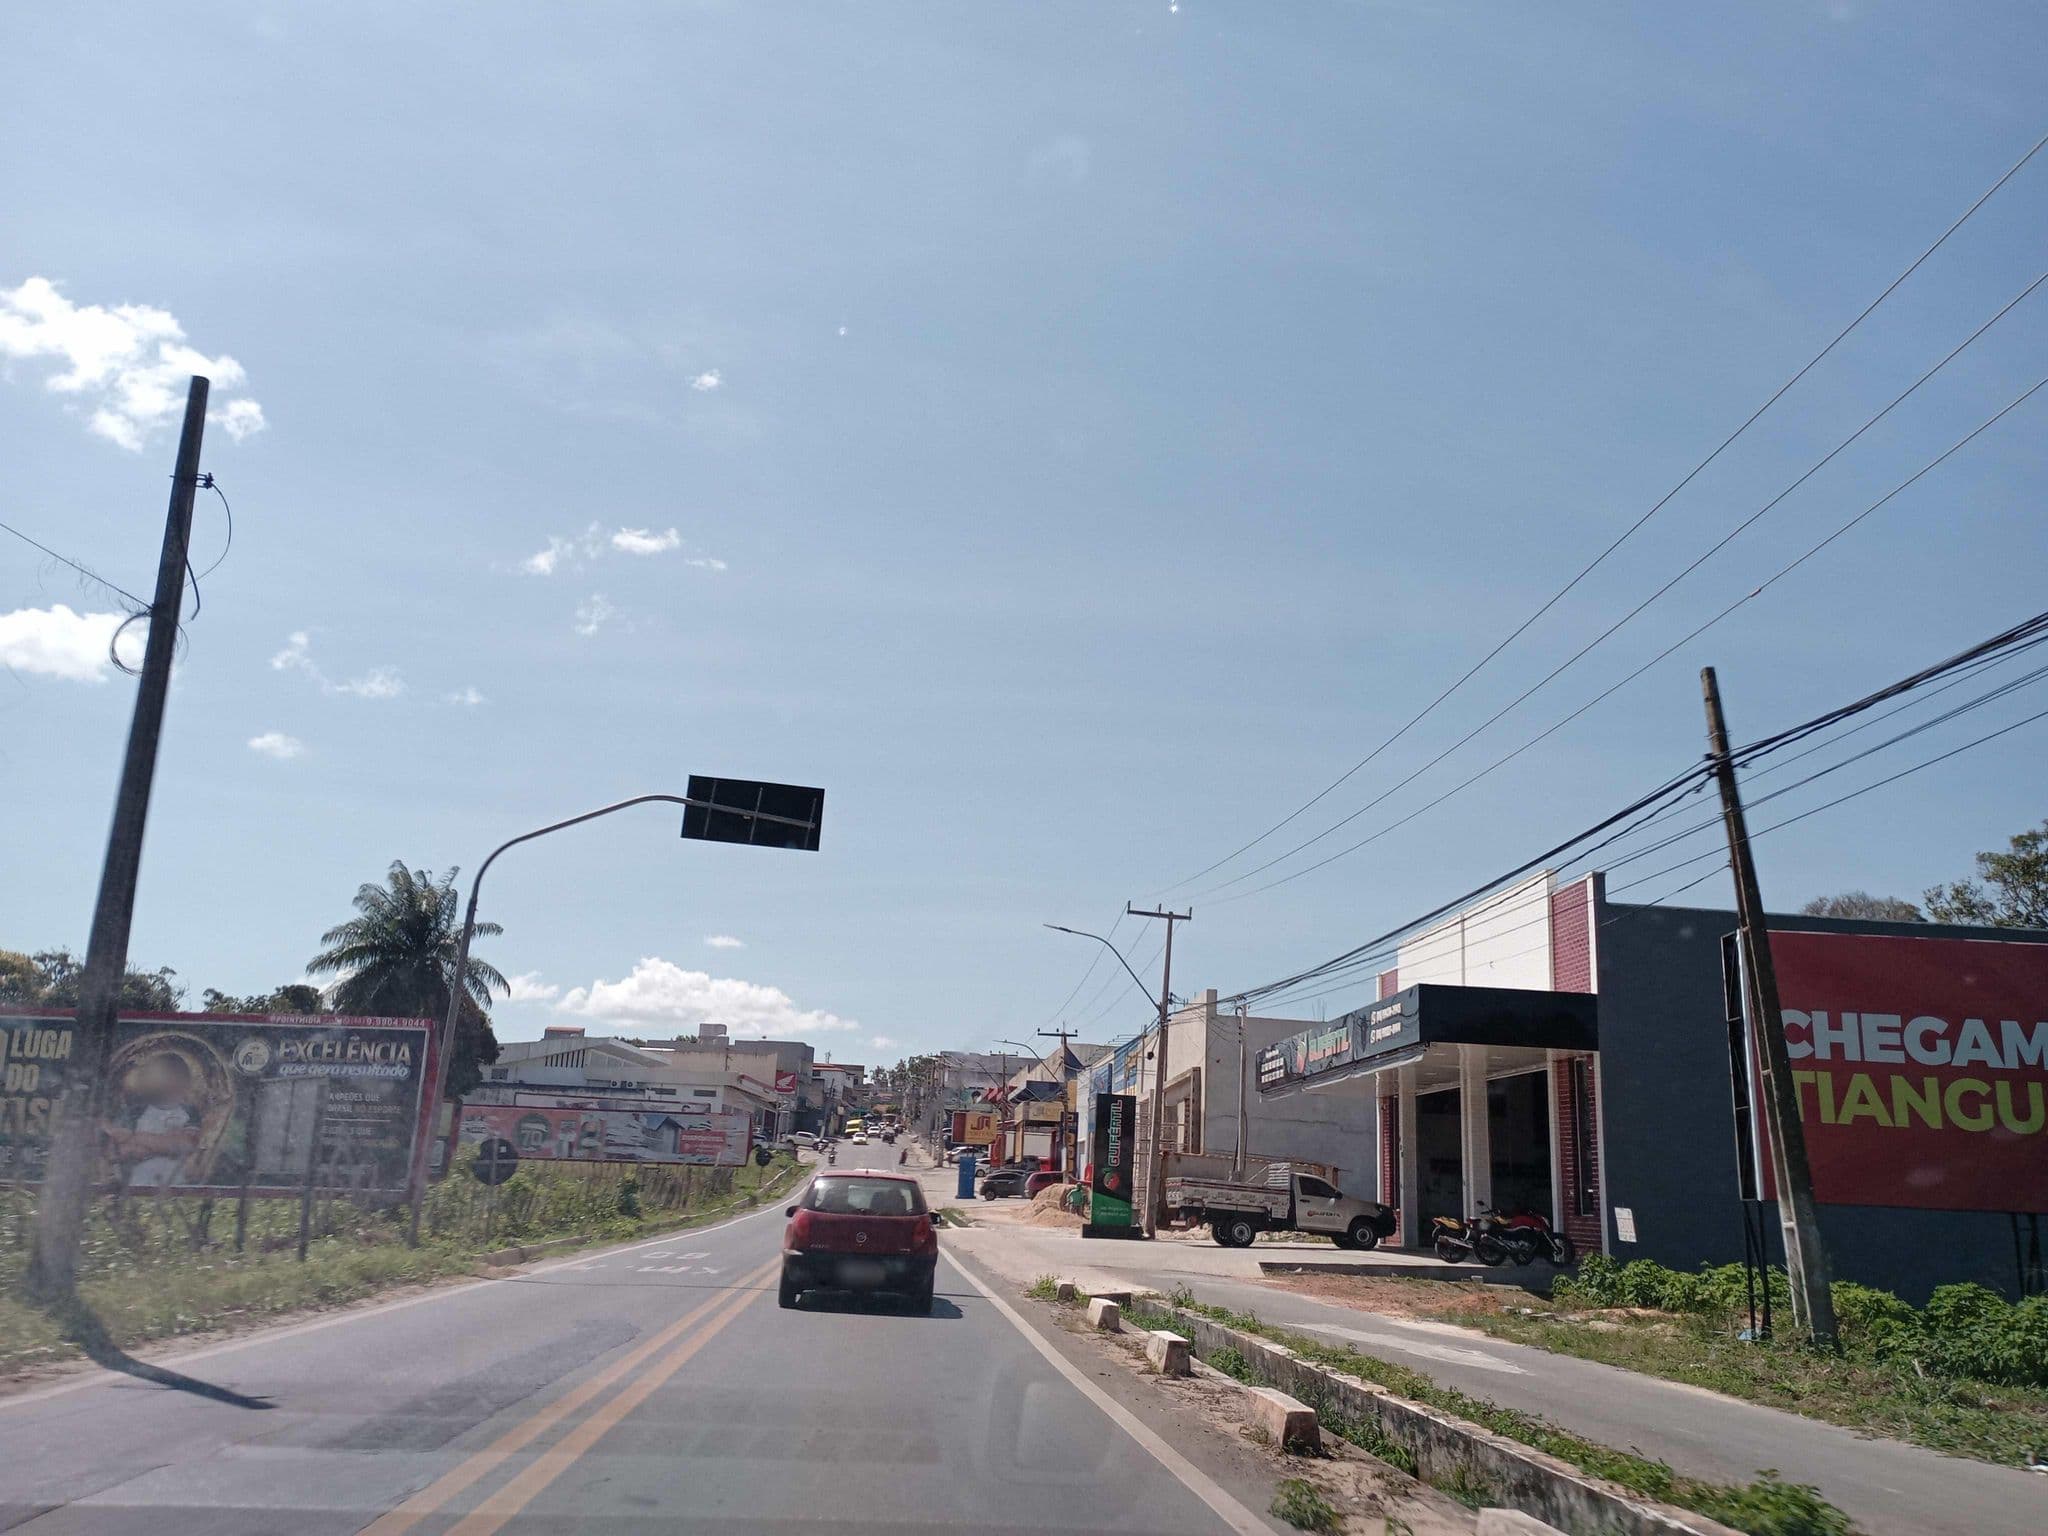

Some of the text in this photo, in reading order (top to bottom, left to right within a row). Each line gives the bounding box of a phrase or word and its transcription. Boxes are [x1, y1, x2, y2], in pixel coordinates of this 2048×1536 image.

[279, 1033, 412, 1066] EXCELÊNCIA
[1781, 1008, 2048, 1071] CHEGAM
[5, 1062, 40, 1092] DO
[1791, 1069, 2048, 1136] TIANGU
[1108, 1099, 1123, 1167] GUIFÉRTIL
